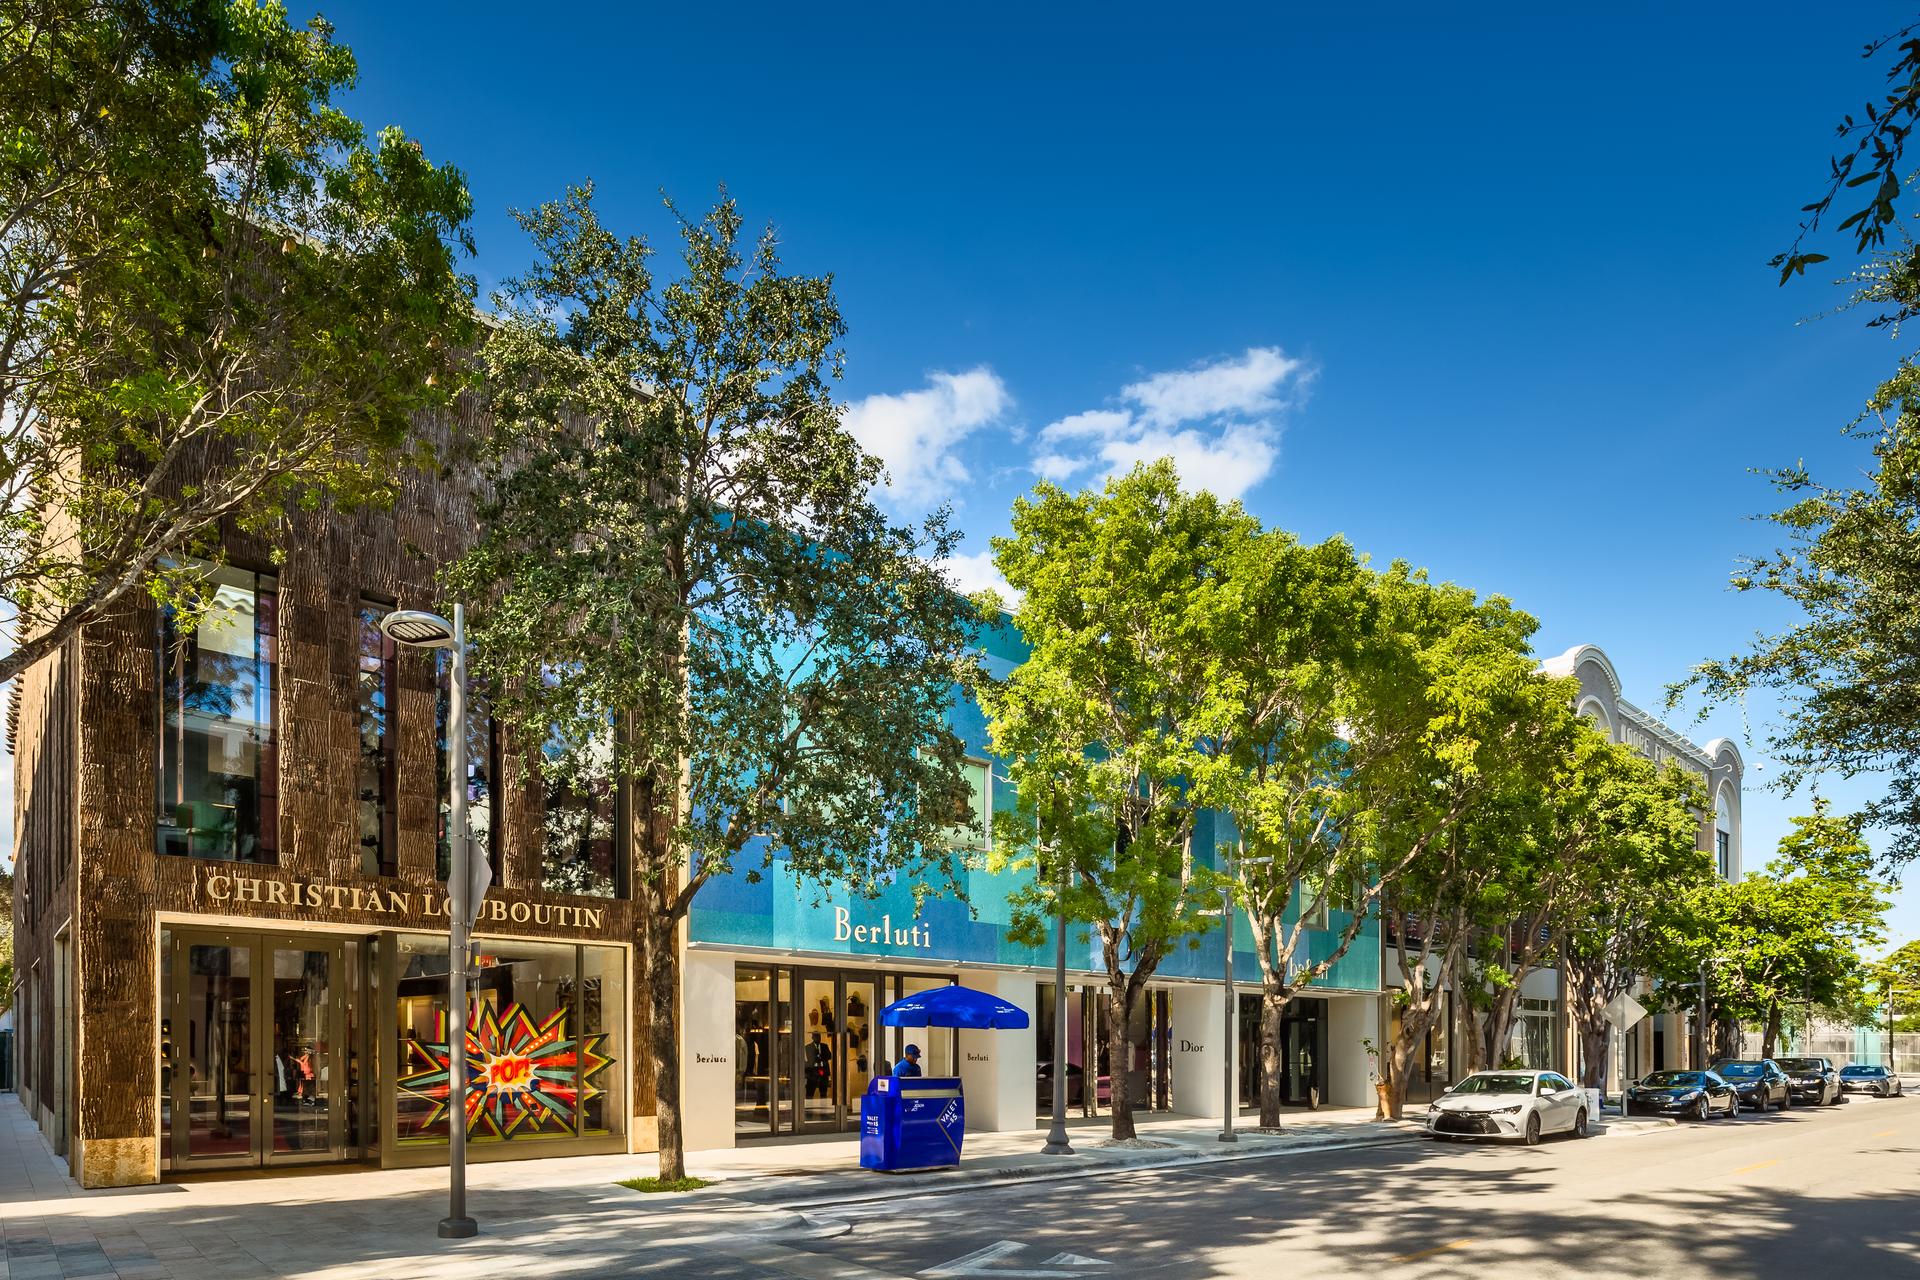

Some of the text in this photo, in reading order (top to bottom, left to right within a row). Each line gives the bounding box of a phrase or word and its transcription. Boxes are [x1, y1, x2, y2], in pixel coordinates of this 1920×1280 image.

[206, 875, 410, 914] CHRISTIAN
[833, 905, 931, 948] Berluti
[967, 1052, 989, 1061] Berluti
[1180, 1039, 1204, 1052] Dior
[696, 1052, 727, 1063] Berluti
[491, 1058, 530, 1084] POP!
[940, 1099, 957, 1122] VALET
